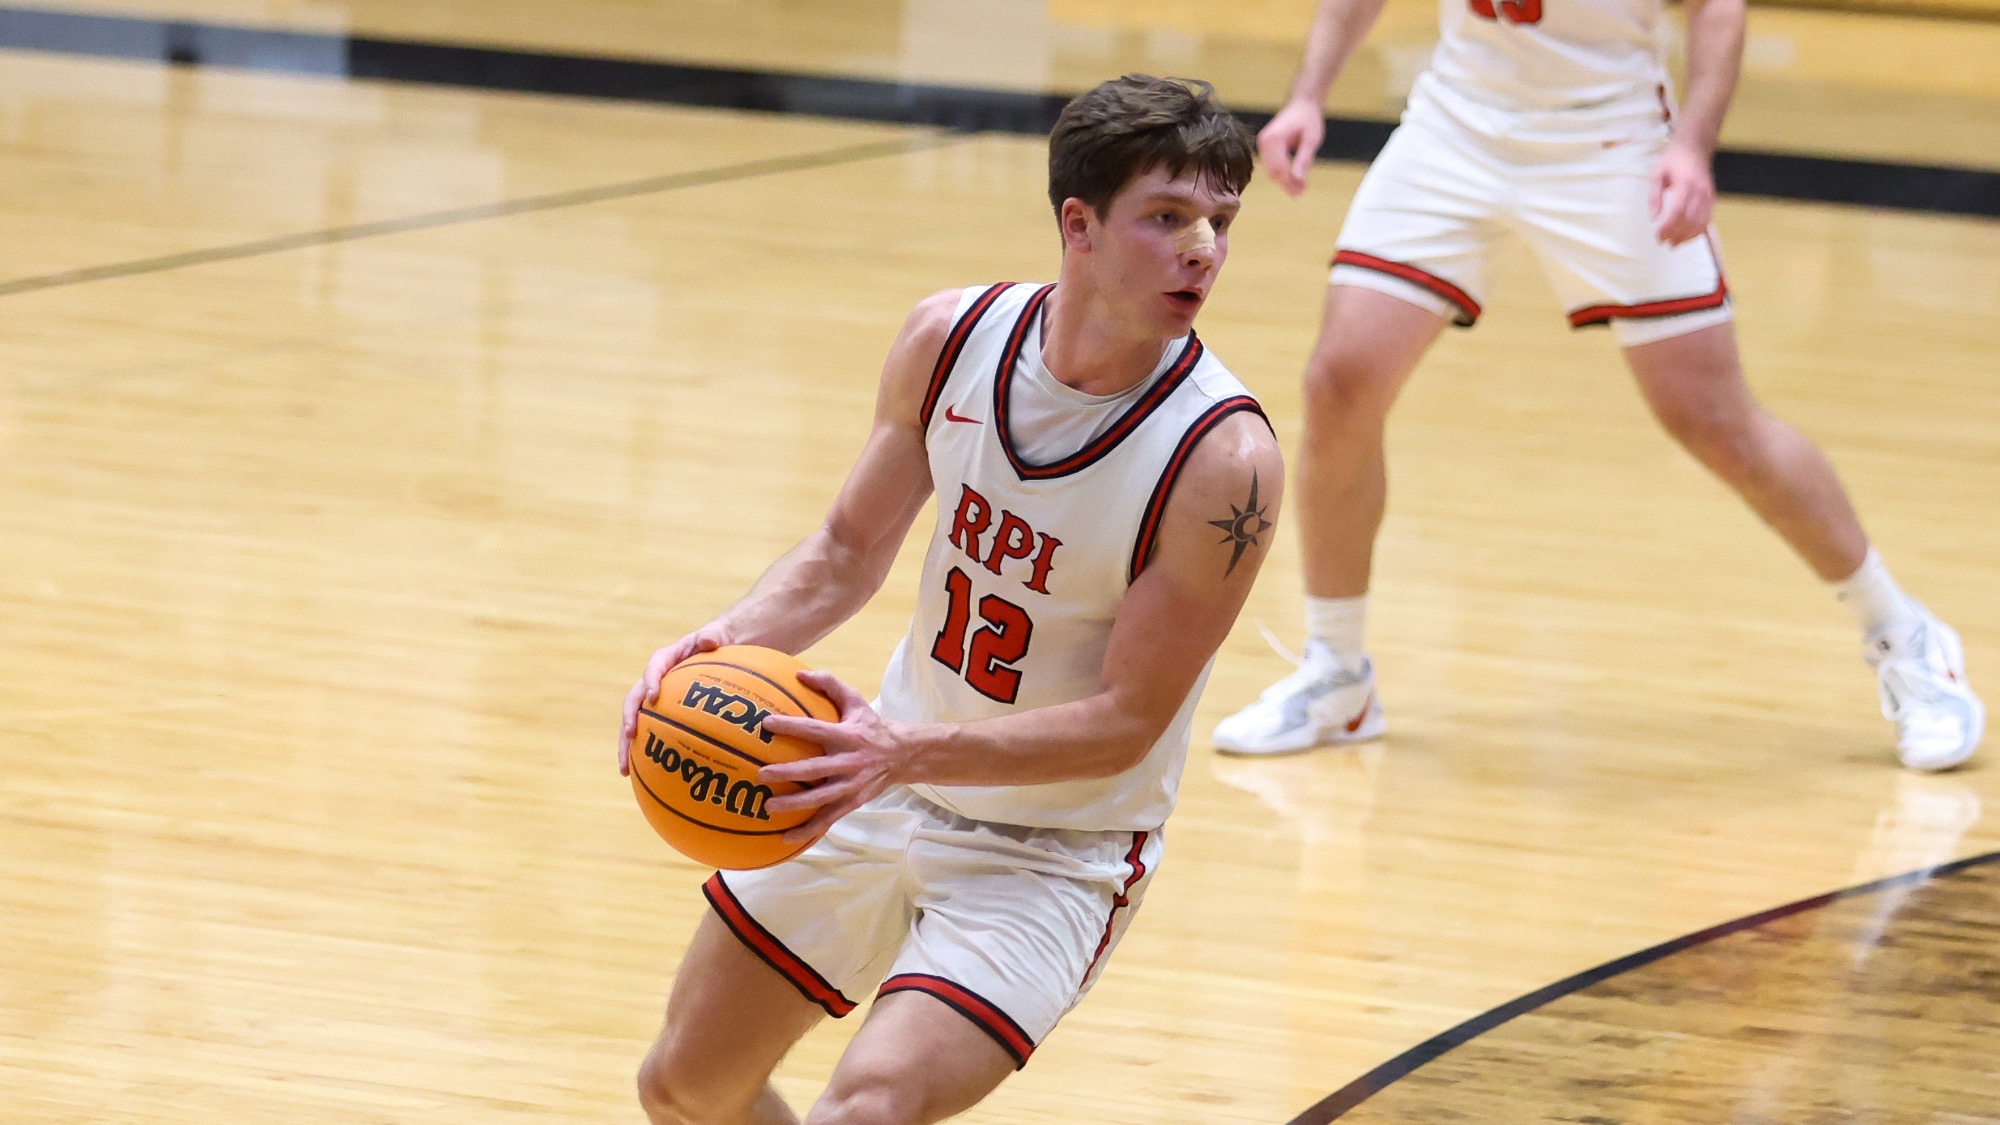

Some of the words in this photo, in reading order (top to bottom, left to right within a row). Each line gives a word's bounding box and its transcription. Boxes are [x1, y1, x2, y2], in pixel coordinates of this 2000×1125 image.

[948, 483, 1063, 595] RPI
[931, 566, 1033, 704] 12
[682, 680, 775, 745] NCAA
[645, 731, 773, 820] Wilson
